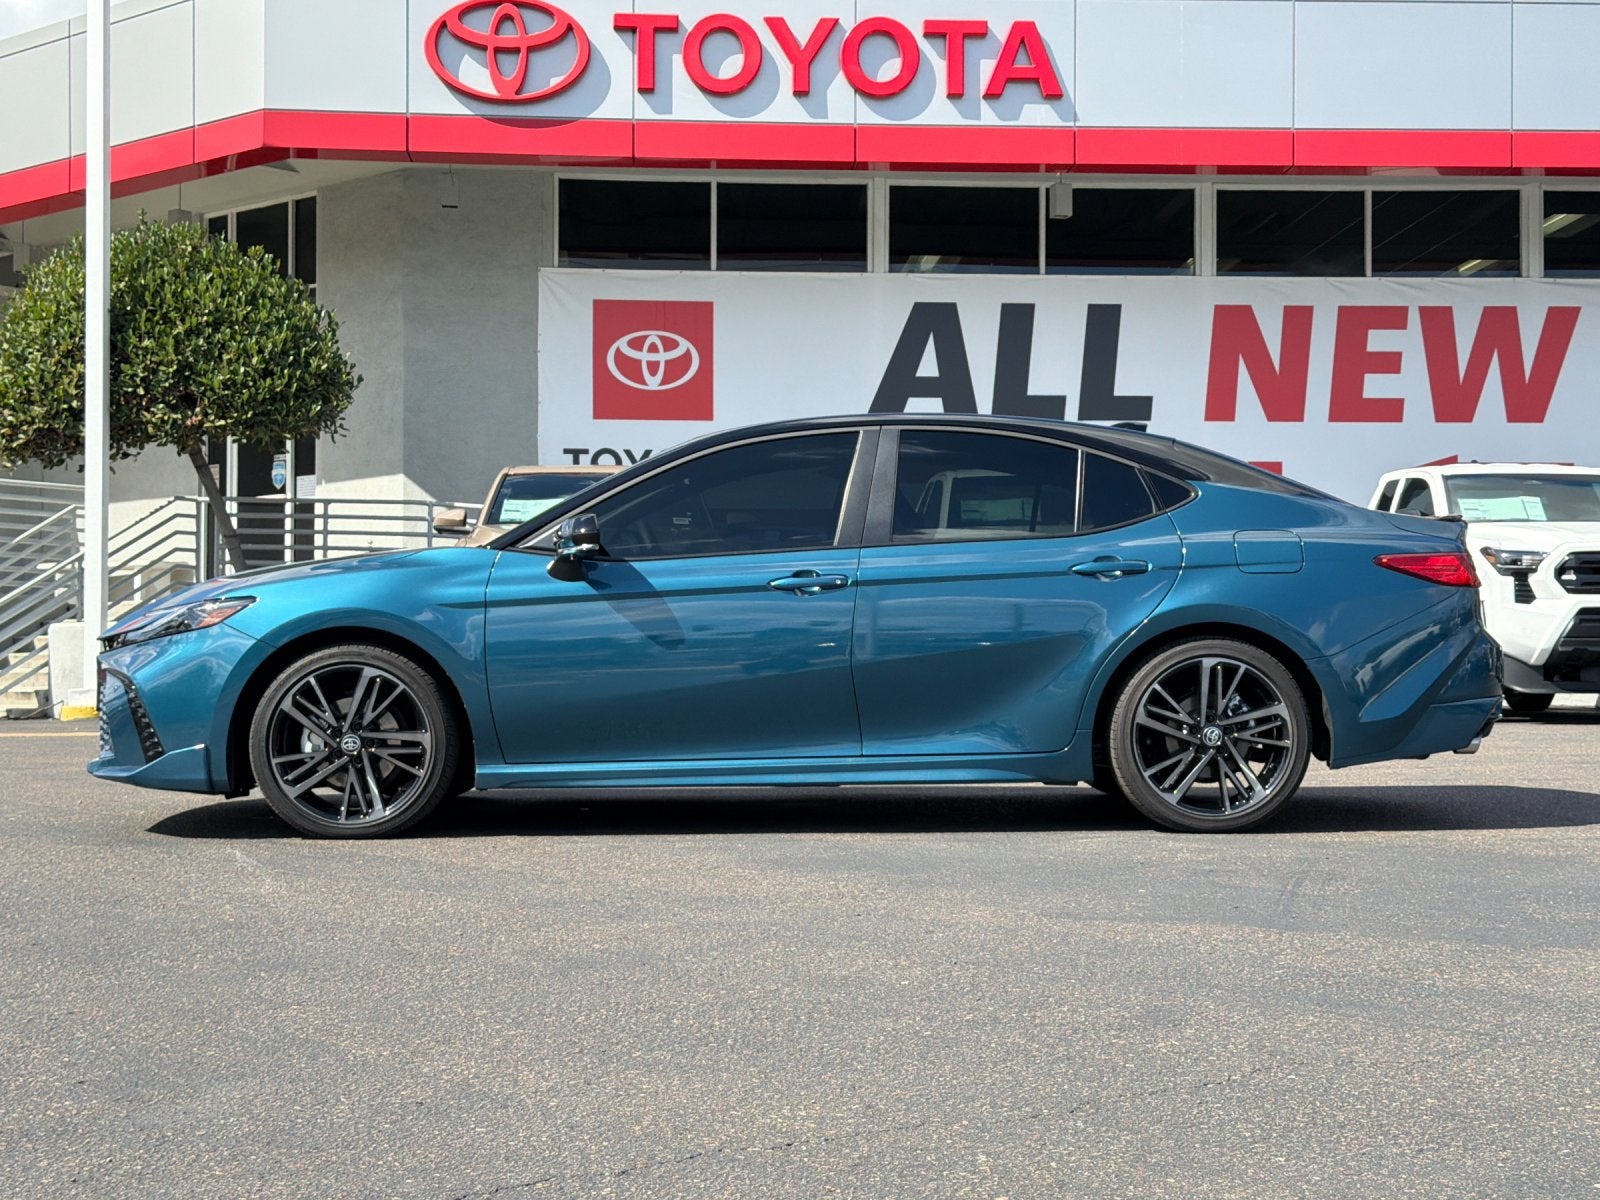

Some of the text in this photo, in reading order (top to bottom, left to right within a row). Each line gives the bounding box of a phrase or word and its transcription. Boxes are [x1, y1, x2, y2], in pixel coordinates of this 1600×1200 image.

[613, 13, 1064, 99] TOYOTA
[868, 301, 1582, 423] ALL NEW
